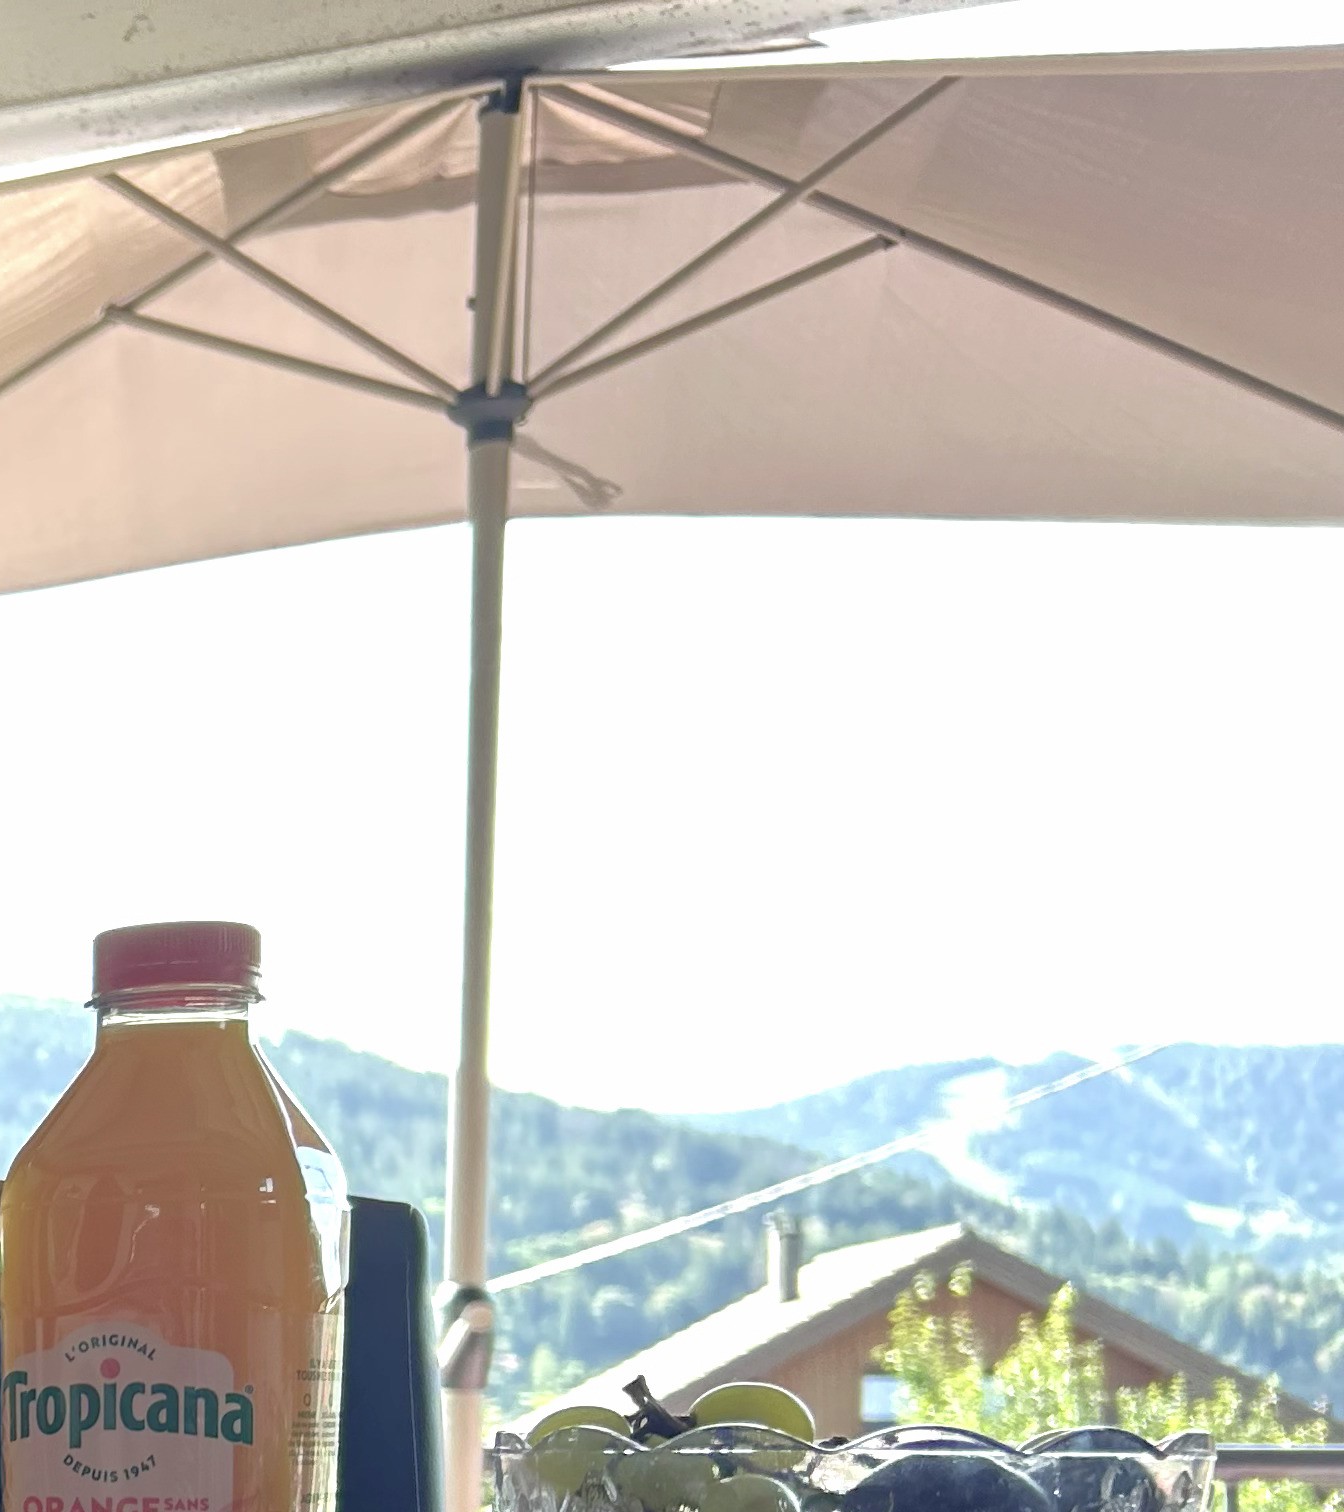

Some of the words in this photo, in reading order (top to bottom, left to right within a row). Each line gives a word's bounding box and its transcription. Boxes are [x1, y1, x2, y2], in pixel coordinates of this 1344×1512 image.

[65, 1334, 156, 1362] L'ORIGINAL
[3, 1358, 254, 1448] Tropicana
[63, 1454, 119, 1482] DEPUIS
[124, 1454, 157, 1481] 1947
[164, 1498, 209, 1511] SANS
